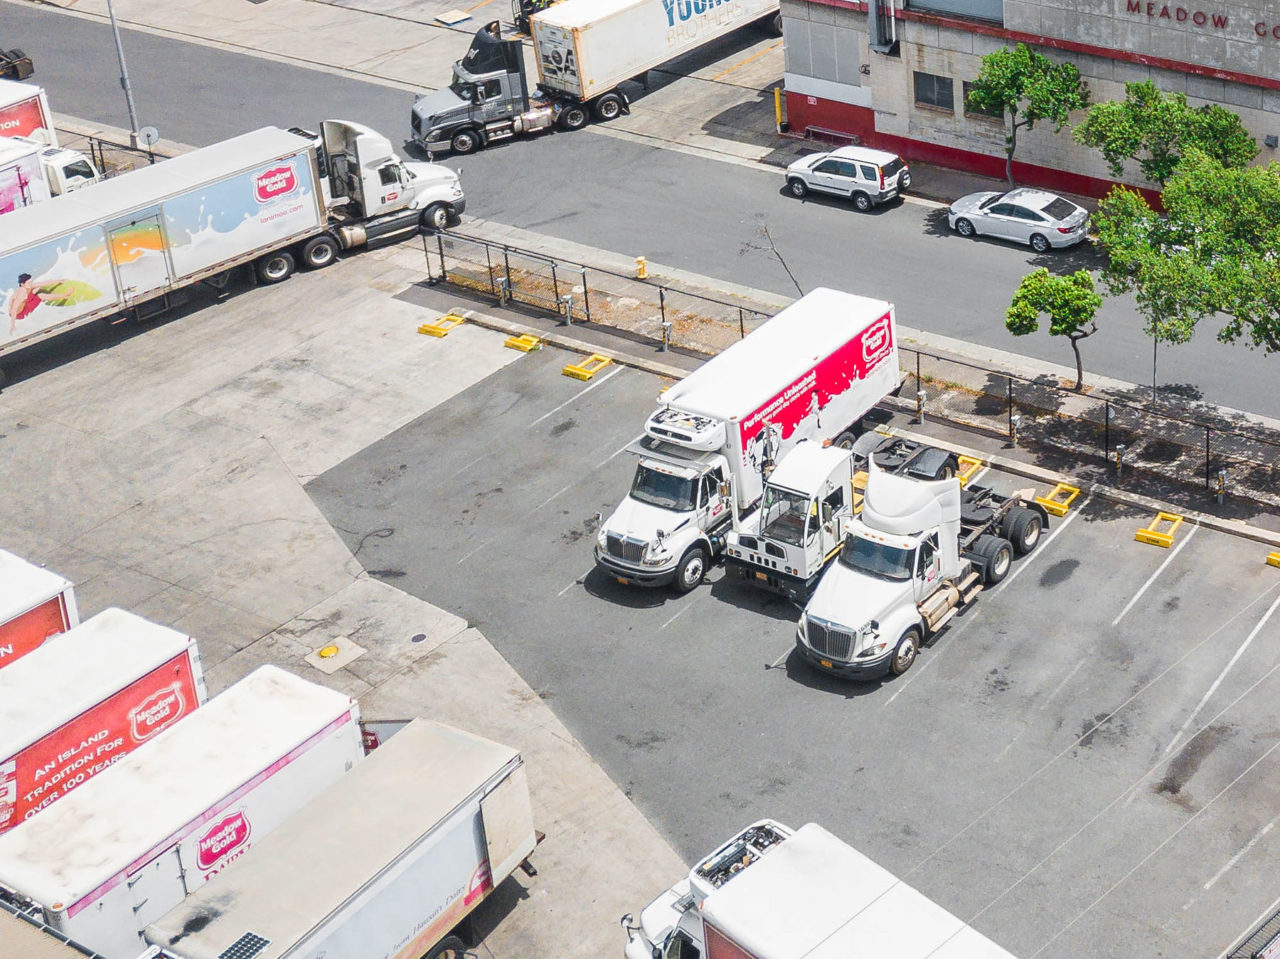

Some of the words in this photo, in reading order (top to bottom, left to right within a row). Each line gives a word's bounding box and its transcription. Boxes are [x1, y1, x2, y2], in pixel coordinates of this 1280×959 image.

[258, 170, 291, 188] Meadow
[266, 179, 287, 192] Gold
[743, 396, 784, 431] Performance
[784, 370, 816, 400] Unleashed
[136, 693, 175, 724] Meadow
[146, 706, 170, 726] Gold
[23, 753, 95, 802] TRADITION
[96, 737, 123, 756] FOR
[34, 761, 56, 781] AN
[57, 729, 109, 763] ISLAND
[24, 791, 59, 820] OVER
[62, 773, 85, 792] 100
[86, 751, 128, 777] YEARS
[201, 818, 242, 852] Meadow
[211, 831, 237, 853] Gold
